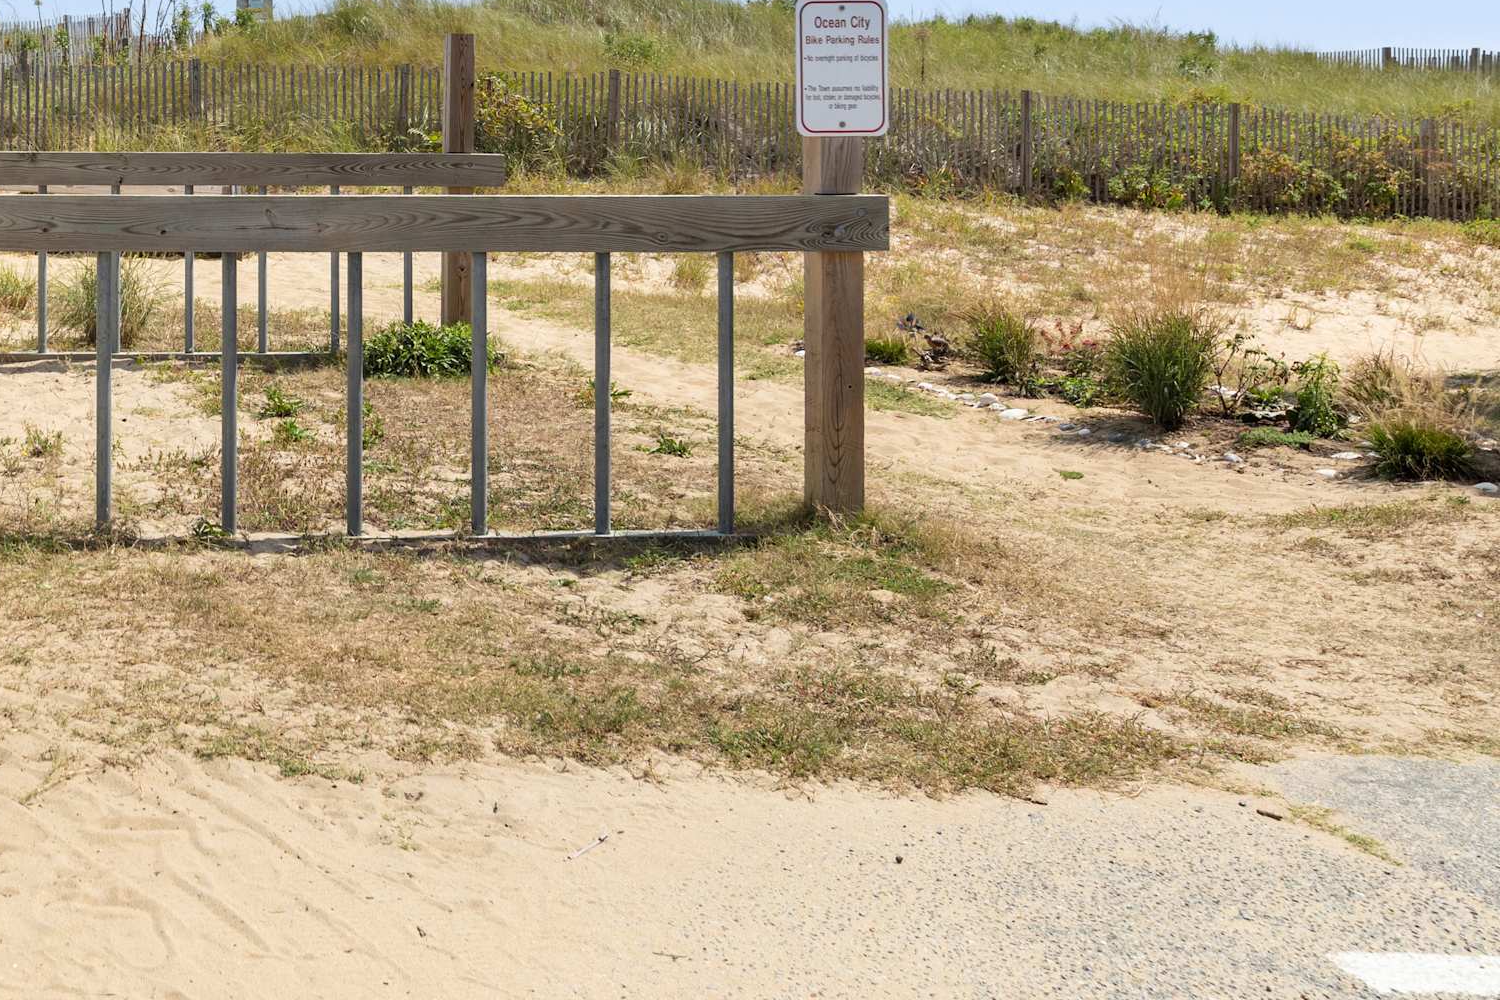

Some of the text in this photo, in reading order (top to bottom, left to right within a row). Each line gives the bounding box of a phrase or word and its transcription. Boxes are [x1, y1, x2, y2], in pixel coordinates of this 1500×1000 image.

[814, 15, 870, 30] Ocean City
[805, 34, 880, 46] Bike Parking Rules
